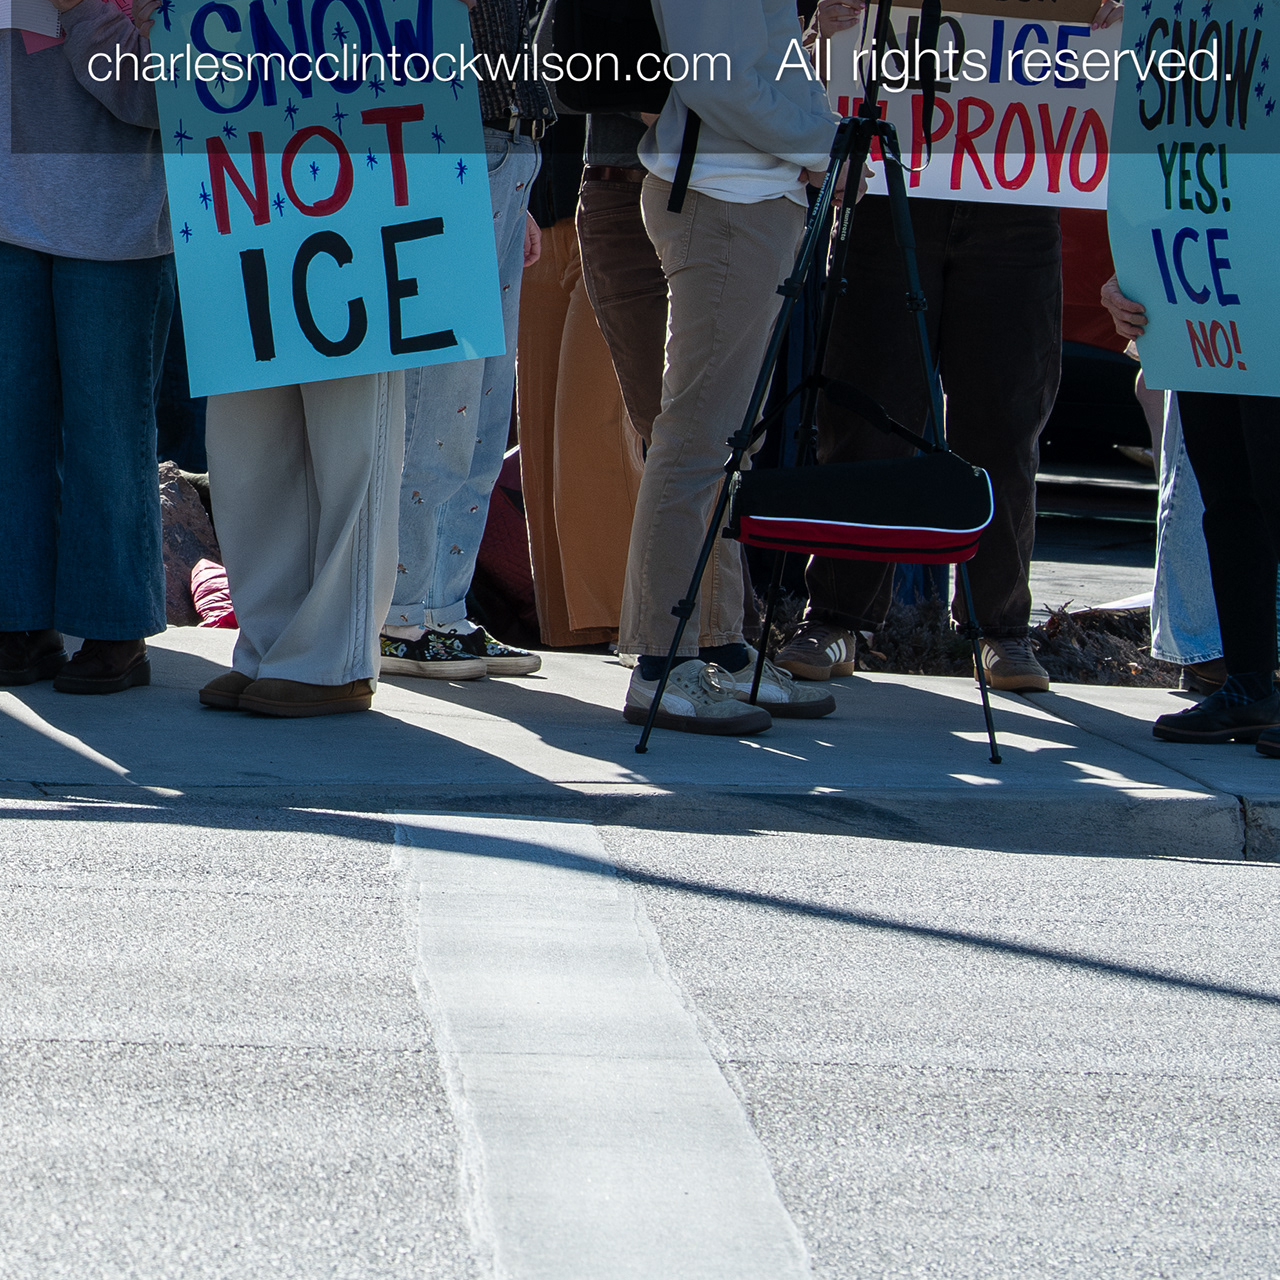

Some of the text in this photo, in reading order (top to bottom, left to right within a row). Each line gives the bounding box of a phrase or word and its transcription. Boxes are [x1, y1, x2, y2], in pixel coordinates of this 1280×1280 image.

[989, 20, 1092, 89] ICE
[1139, 15, 1263, 131] SNOW
[206, 104, 425, 235] NOT
[909, 93, 1109, 194] PROVO
[1157, 141, 1231, 215] YES!
[840, 207, 851, 241] Manfrotto
[239, 216, 458, 362] ICE
[1151, 227, 1241, 307] ICE
[1186, 320, 1248, 372] NO!
